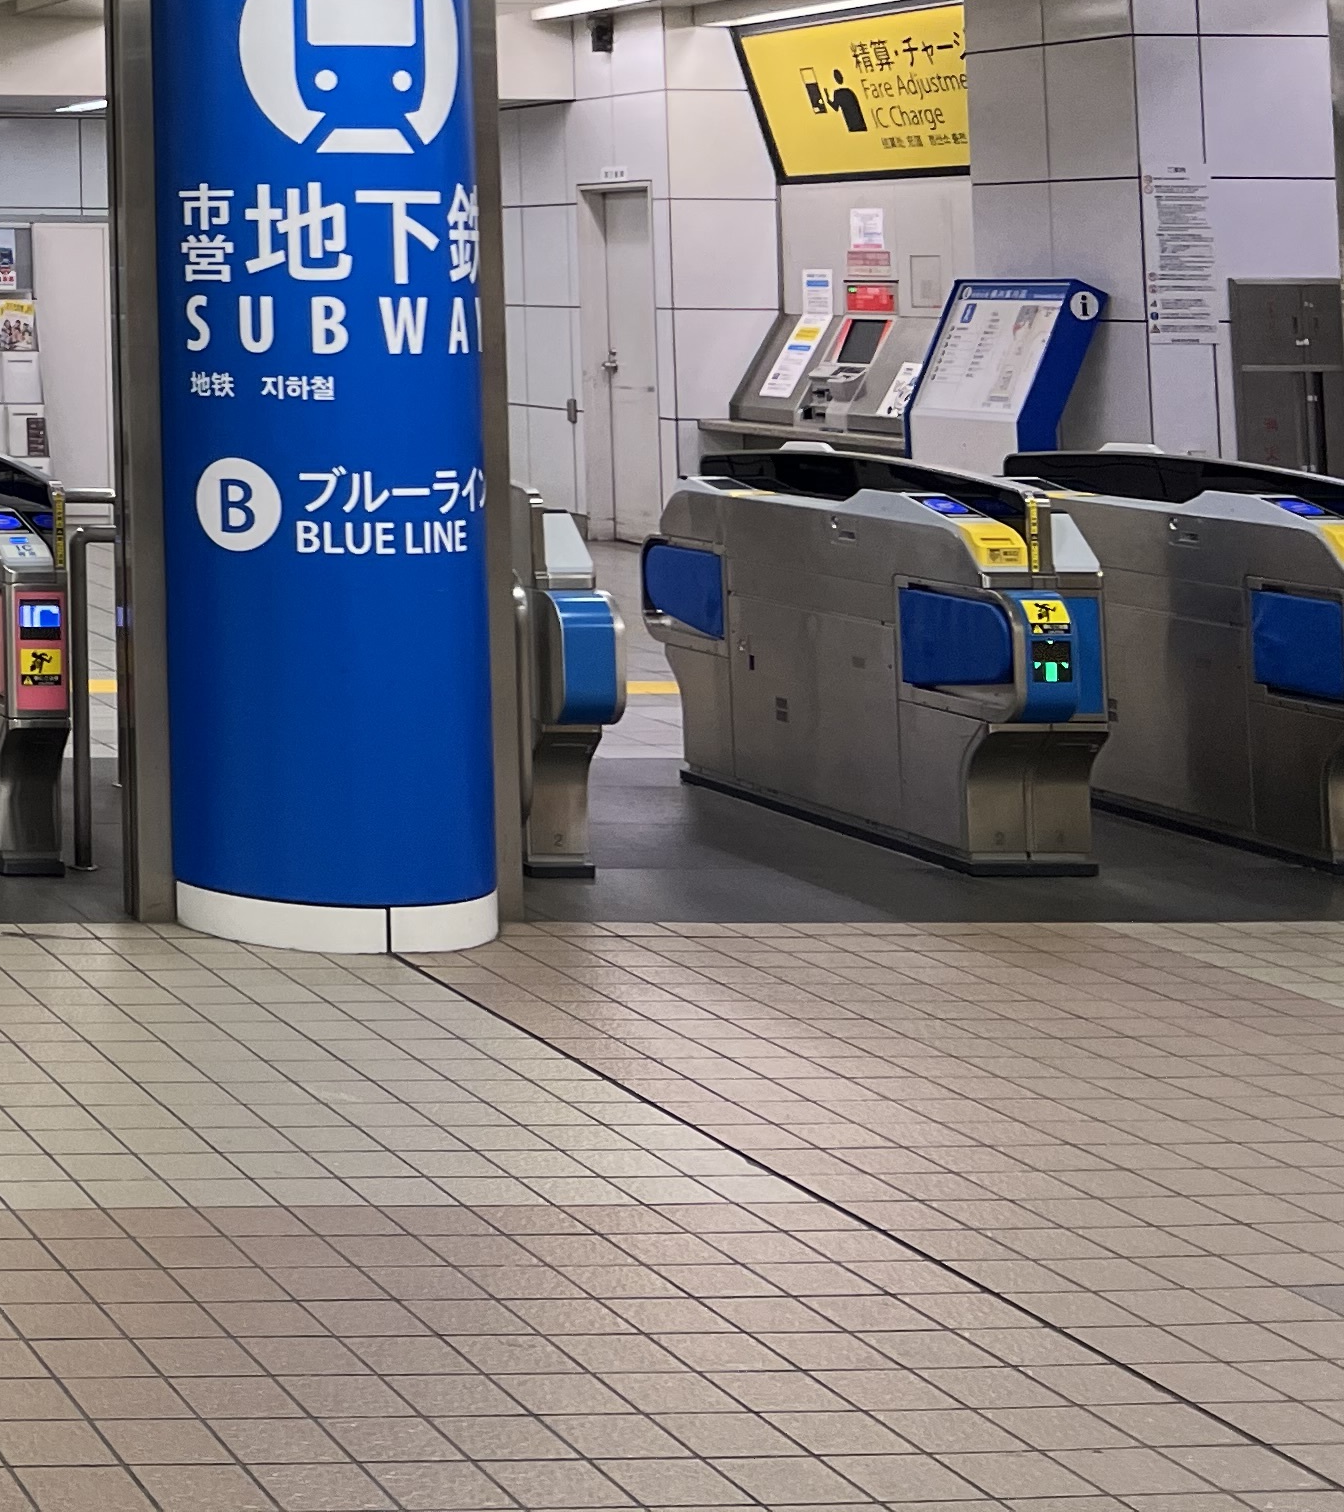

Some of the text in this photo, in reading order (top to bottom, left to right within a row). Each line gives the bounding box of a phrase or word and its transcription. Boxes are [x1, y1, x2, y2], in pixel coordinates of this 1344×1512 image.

[860, 78, 895, 101] Fare
[871, 105, 945, 131] IC Charge
[190, 371, 236, 397] 地铁
[261, 375, 336, 401] 지하철
[295, 518, 468, 556] BLUE LINE
[553, 833, 564, 849] 2
